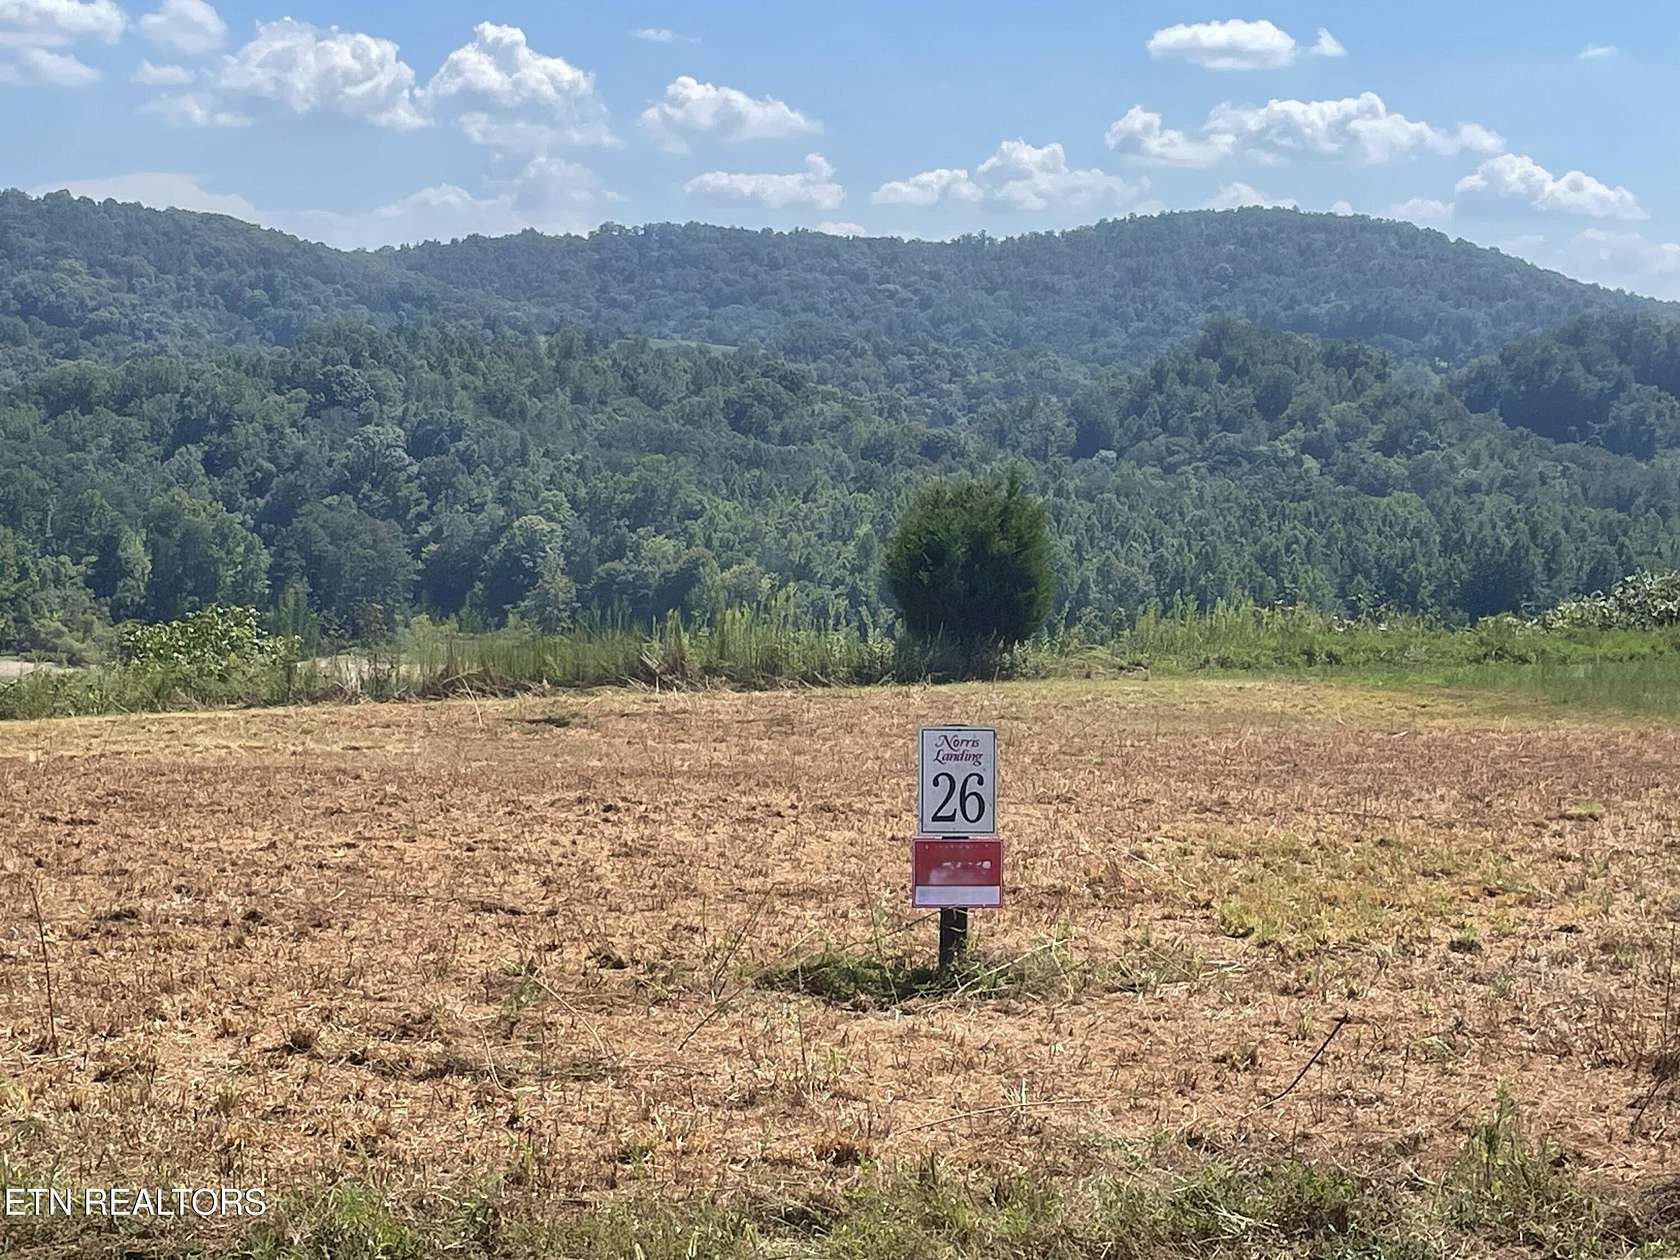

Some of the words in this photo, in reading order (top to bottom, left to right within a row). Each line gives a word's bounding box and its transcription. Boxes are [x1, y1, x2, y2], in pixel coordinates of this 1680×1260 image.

[935, 734, 980, 751] Norris
[933, 748, 984, 766] Landing
[931, 772, 986, 824] 26
